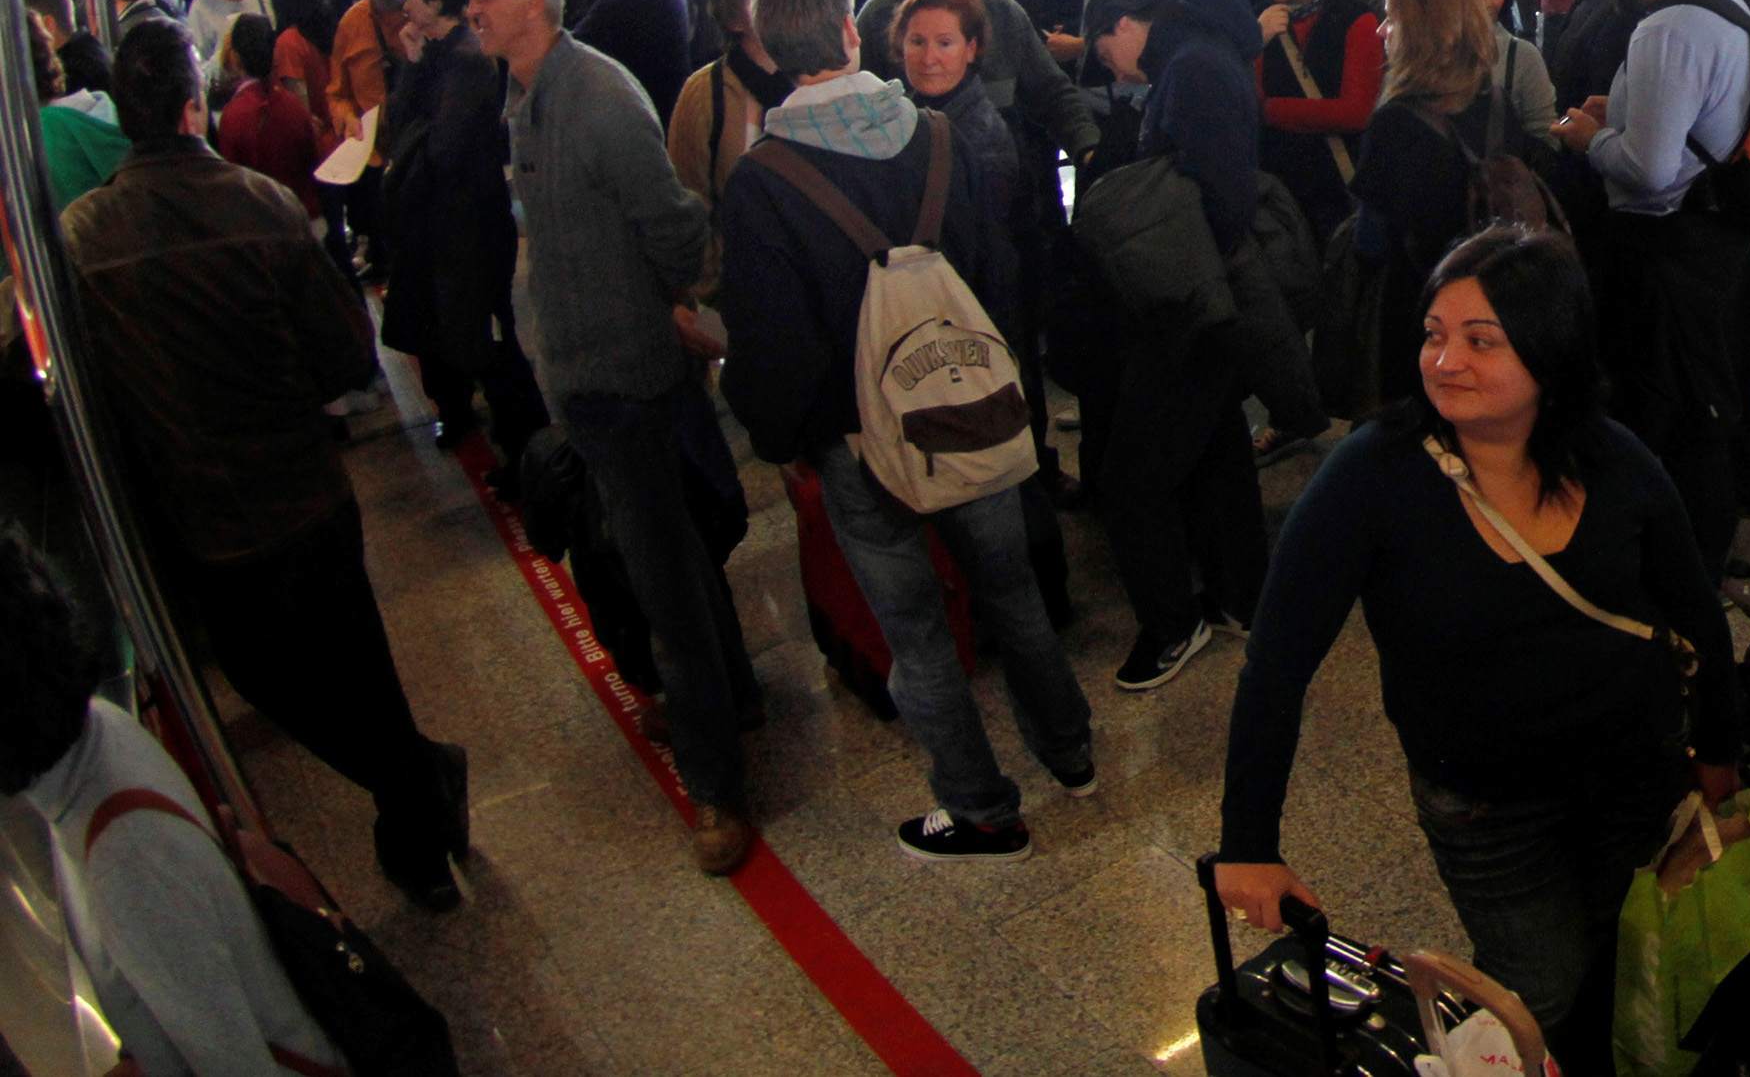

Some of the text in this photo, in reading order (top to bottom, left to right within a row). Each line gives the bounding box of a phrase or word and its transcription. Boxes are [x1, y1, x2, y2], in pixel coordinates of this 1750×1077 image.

[532, 558, 605, 663] Bitte hier warten
[604, 672, 639, 712] turno
